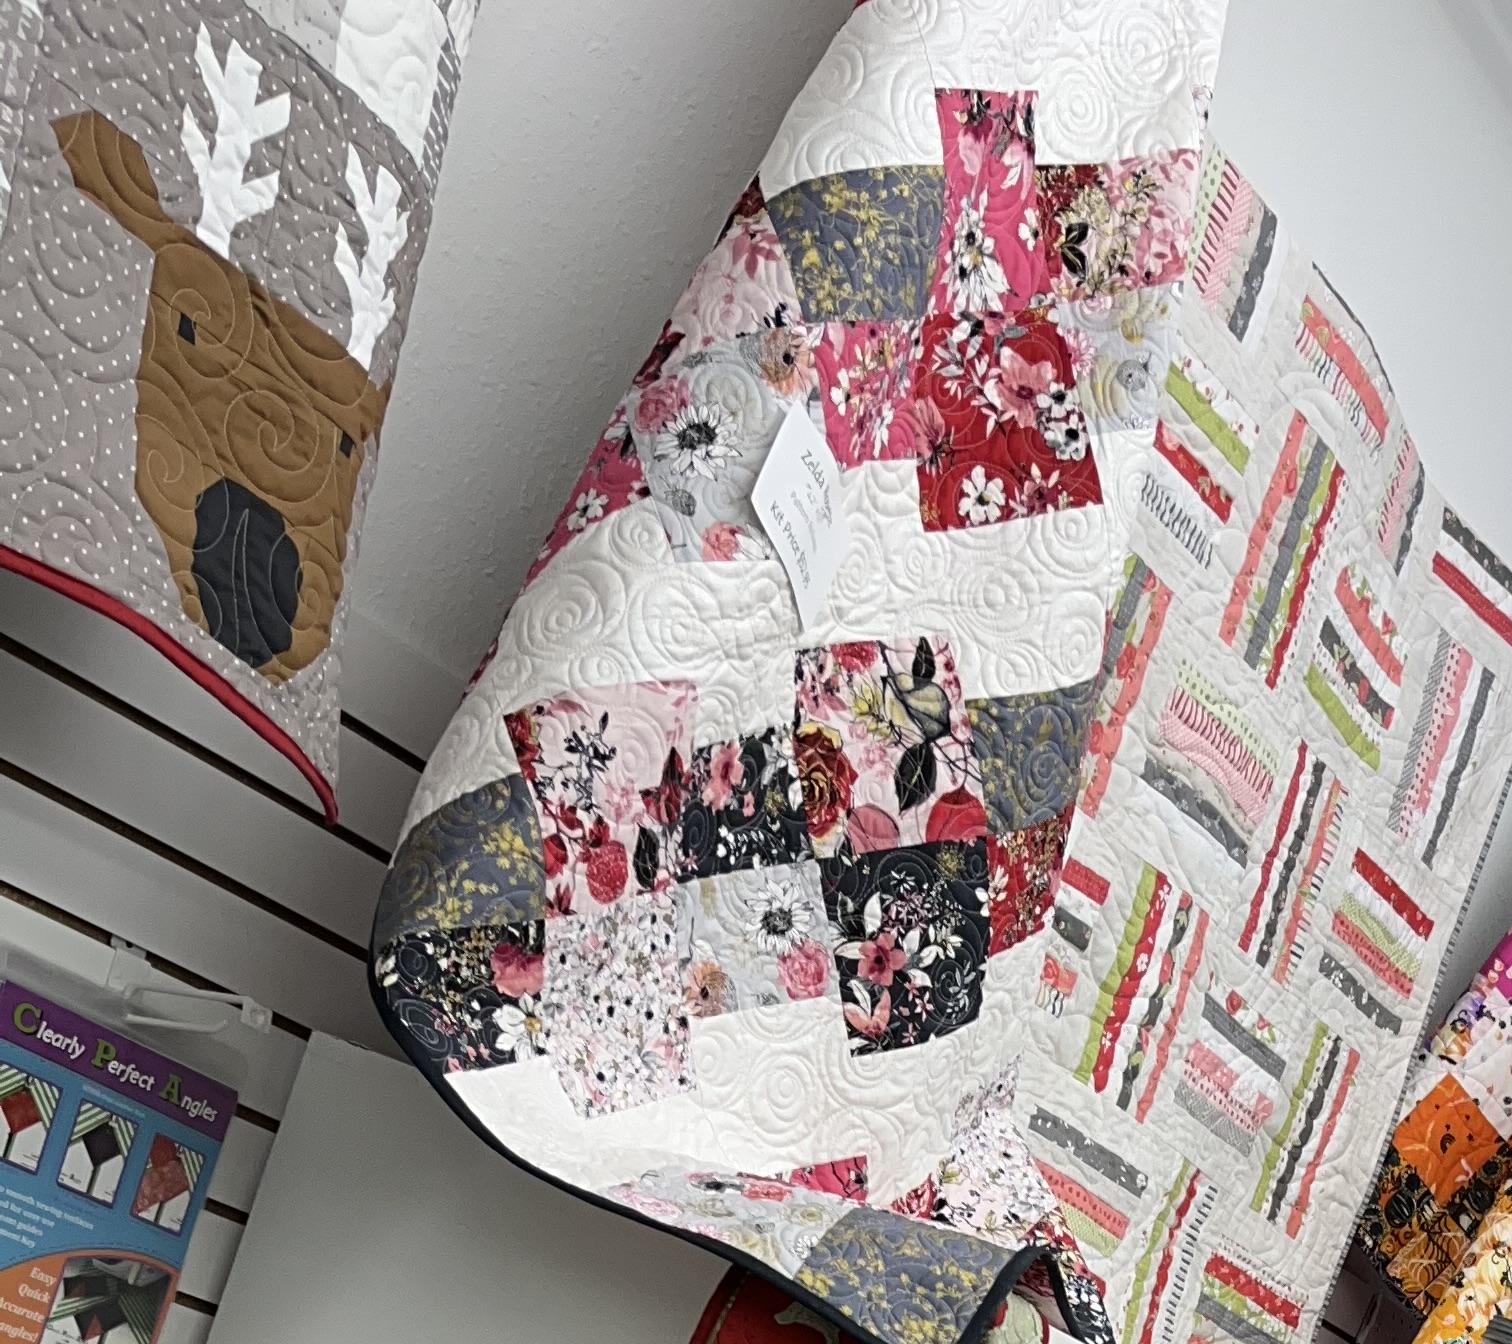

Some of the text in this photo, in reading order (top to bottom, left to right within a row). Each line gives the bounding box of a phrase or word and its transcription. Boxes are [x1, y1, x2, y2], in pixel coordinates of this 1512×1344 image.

[13, 1002, 86, 1060] Clearly
[91, 1039, 156, 1092] Perfect
[160, 1073, 218, 1122] Angles
[30, 1266, 57, 1287] Easy
[18, 1283, 50, 1304] Quick
